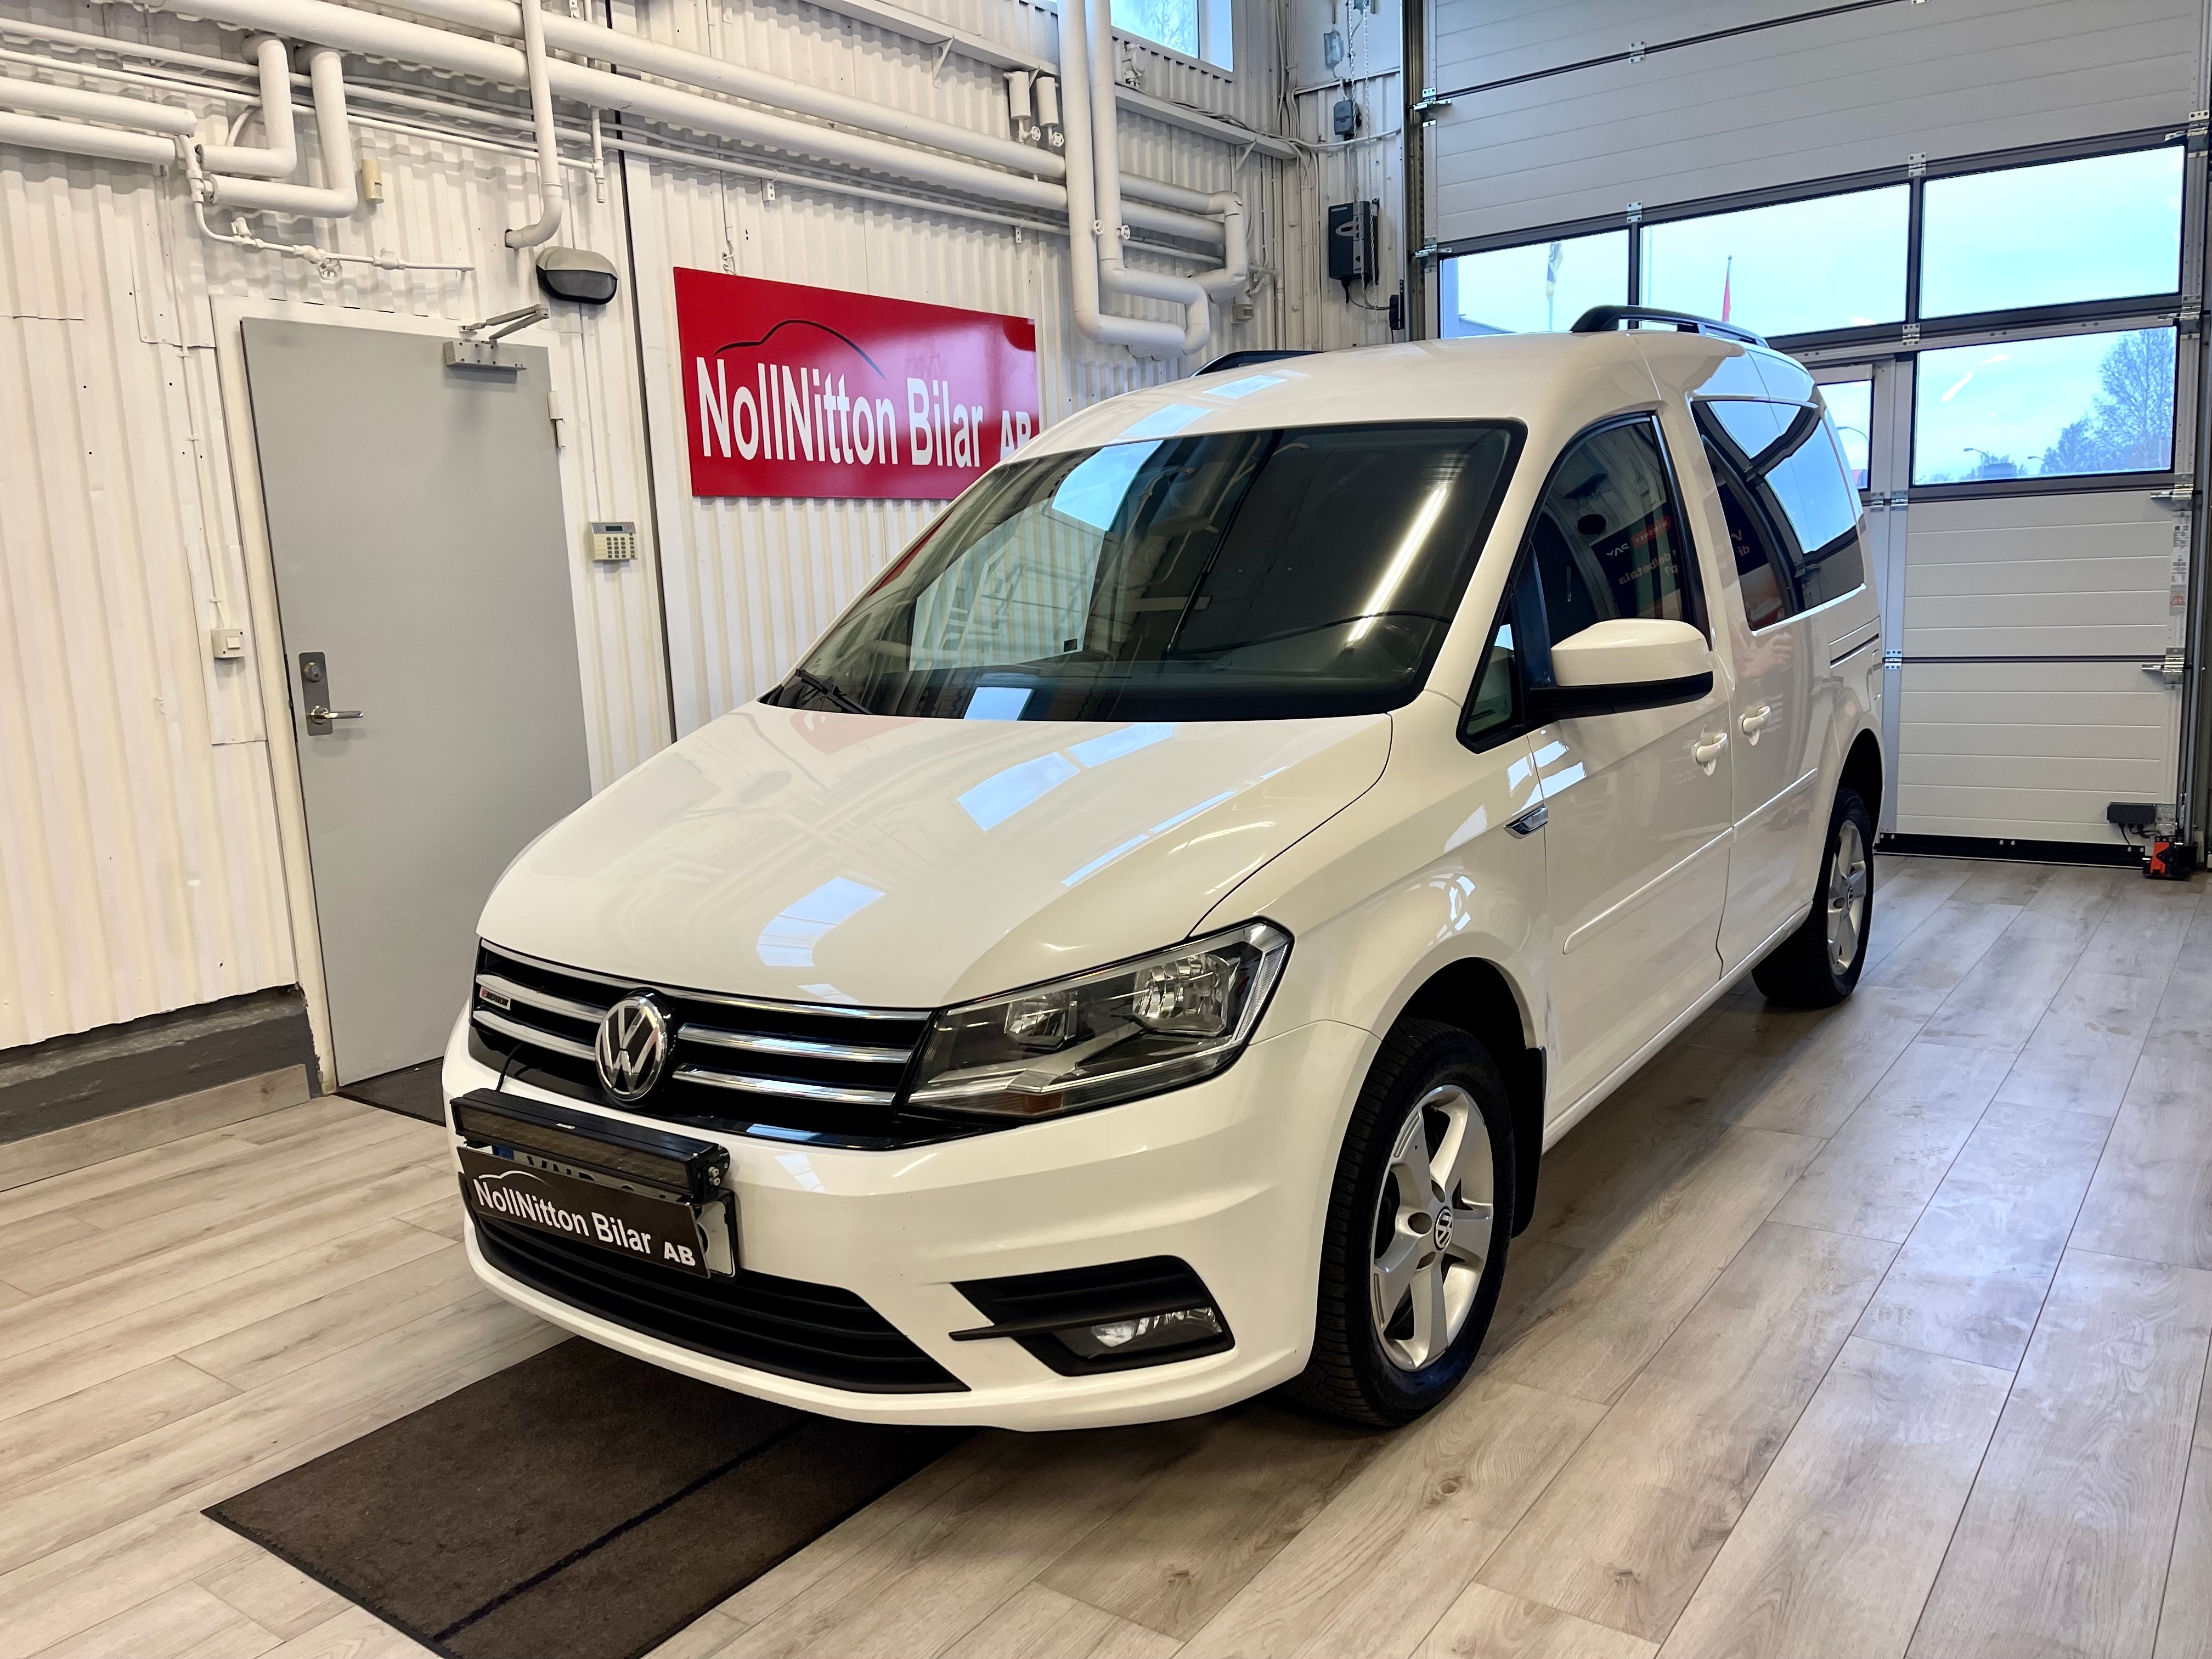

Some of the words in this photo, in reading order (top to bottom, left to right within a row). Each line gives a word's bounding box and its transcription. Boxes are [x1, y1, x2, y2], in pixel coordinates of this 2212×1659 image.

[697, 356, 898, 465] NollNitton
[907, 377, 984, 467] Bilar
[1001, 410, 1031, 460] AB
[473, 1178, 589, 1237] NollNitton
[591, 1212, 652, 1255] Bilar
[664, 1242, 696, 1267] AB
